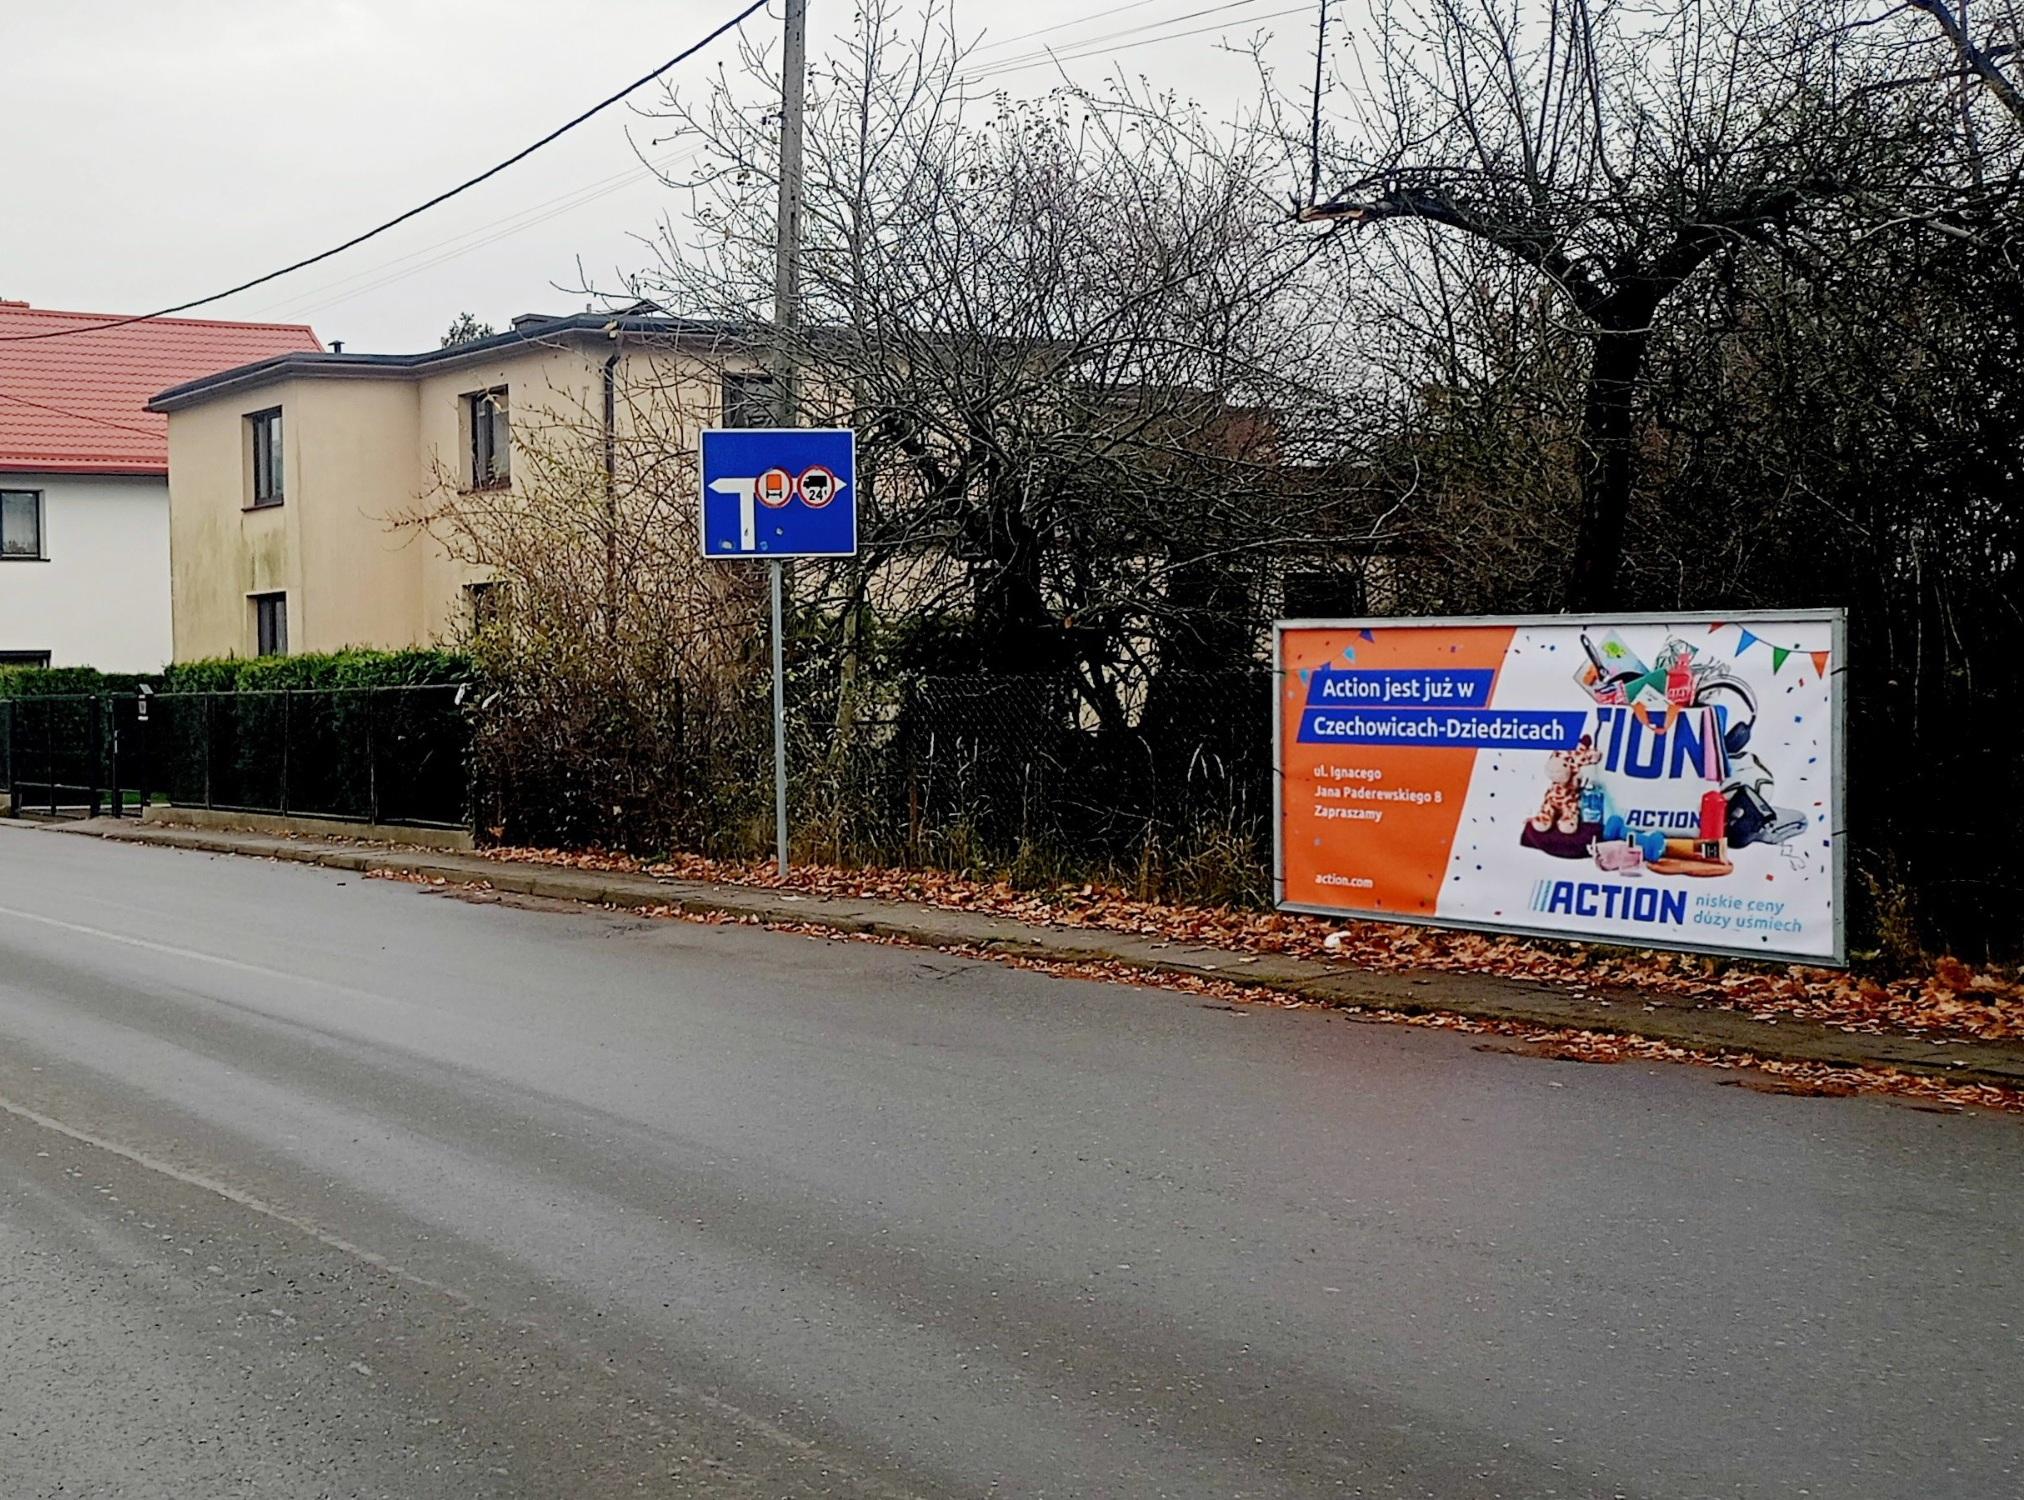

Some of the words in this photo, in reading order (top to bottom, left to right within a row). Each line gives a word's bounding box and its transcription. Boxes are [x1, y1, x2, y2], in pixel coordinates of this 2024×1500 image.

[1322, 678, 1380, 698] Action
[1383, 679, 1420, 702] jest
[1422, 678, 1453, 702] już
[1457, 682, 1475, 698] w
[1313, 716, 1565, 741] Czechowicach-Dziedzicach
[1597, 707, 1705, 779] ION
[1313, 764, 1328, 777] ul.
[1330, 765, 1382, 782] Ignacego
[1314, 785, 1341, 798] Jana
[1343, 786, 1432, 805] Paderewskiego
[1433, 790, 1443, 803] 8
[1314, 804, 1383, 823] Zapraszamy
[1314, 872, 1374, 888] action.com
[1548, 880, 1688, 926] ACTION
[1695, 893, 1743, 910] niskie
[1746, 900, 1785, 916] ceny
[1735, 914, 1803, 933] uśmiech
